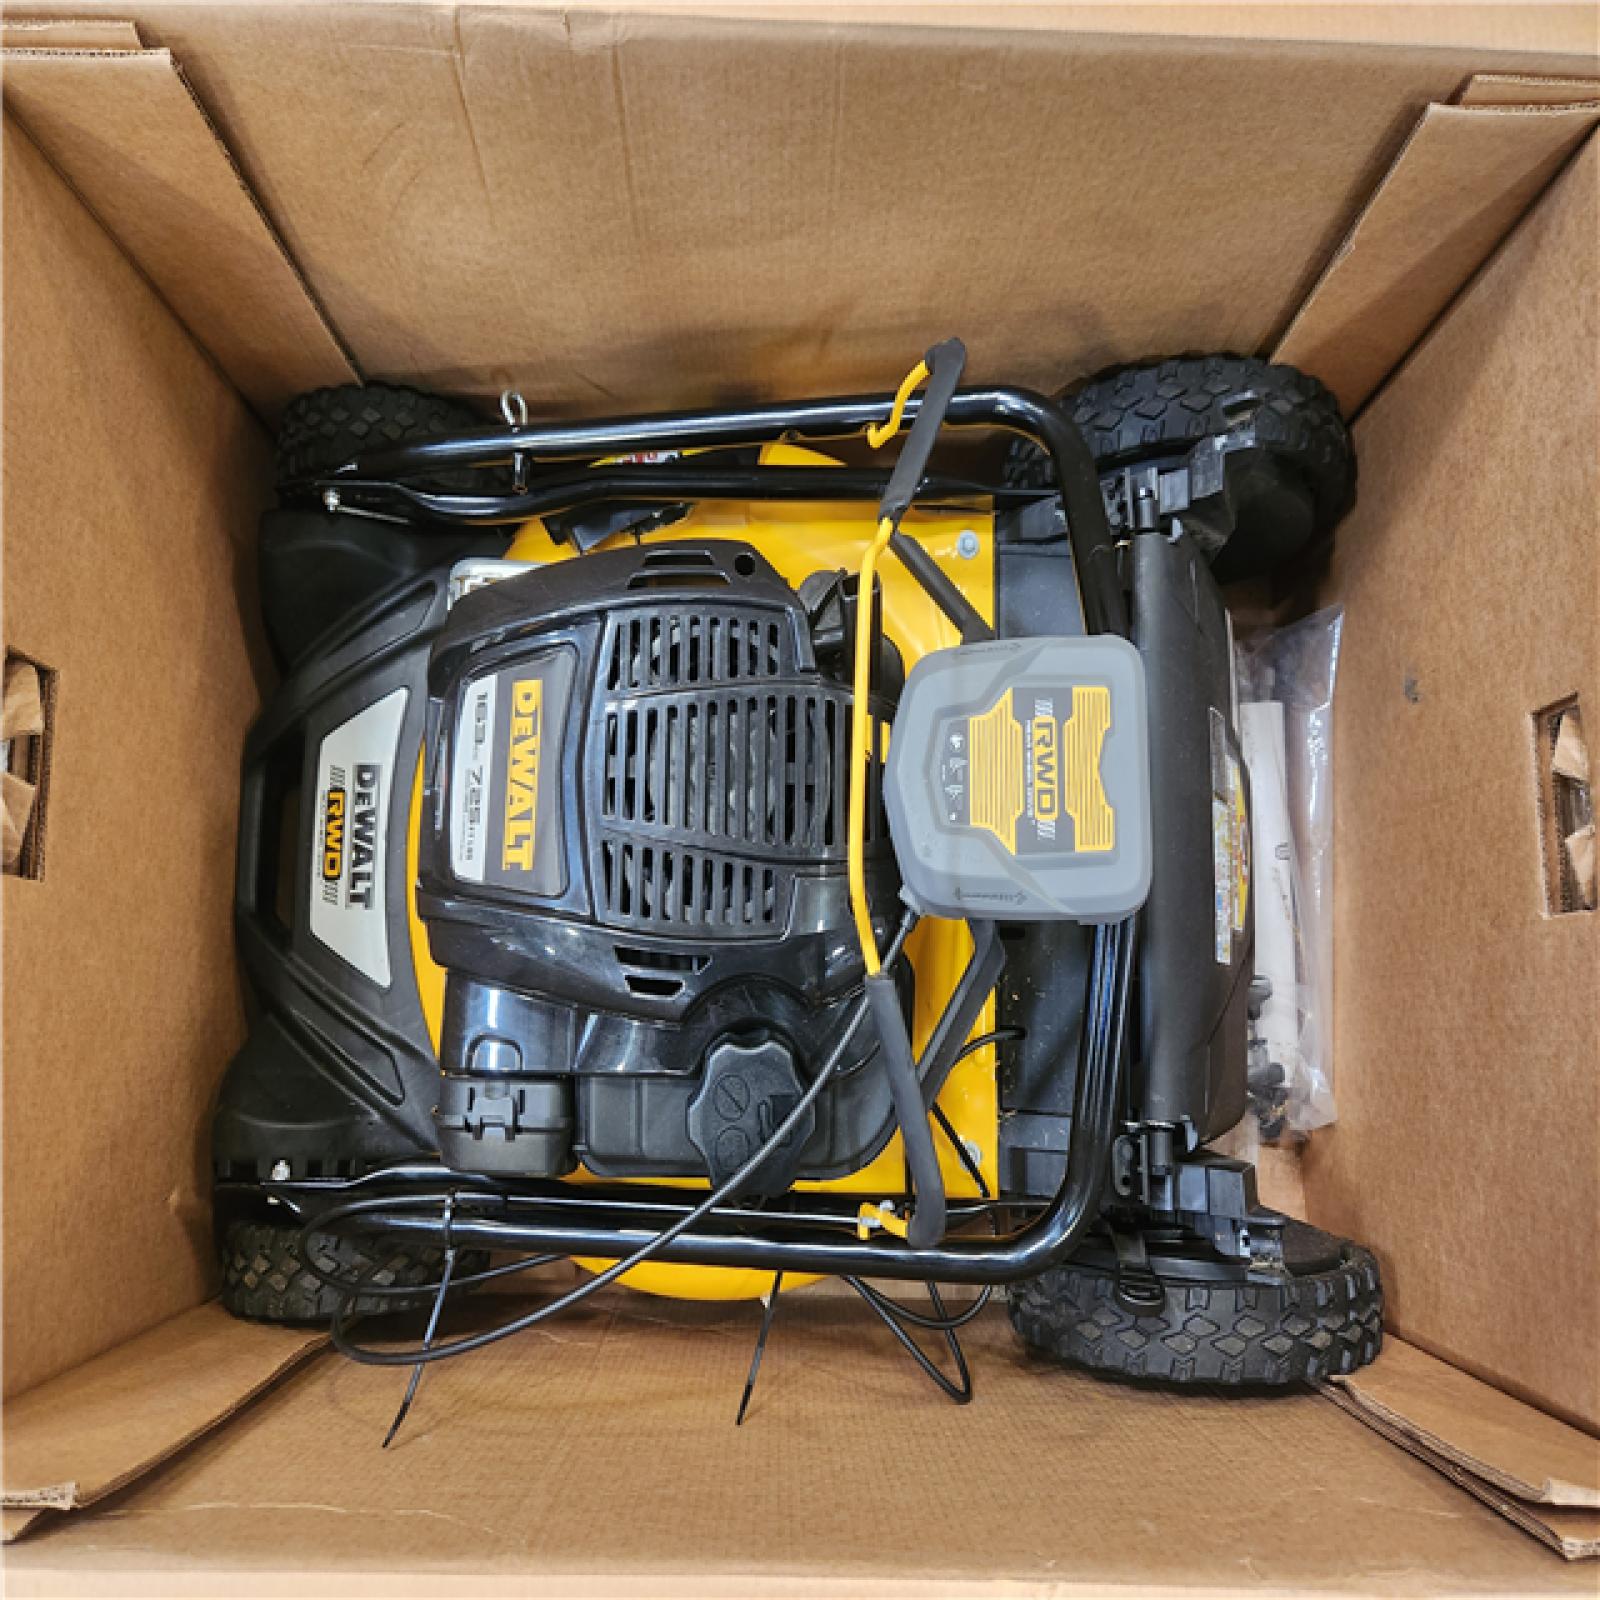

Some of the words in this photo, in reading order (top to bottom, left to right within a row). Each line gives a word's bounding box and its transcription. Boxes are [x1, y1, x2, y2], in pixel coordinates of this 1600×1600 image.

[502, 679, 543, 871] DEWALT
[1035, 720, 1057, 817] RWD
[323, 790, 345, 880] RWD
[347, 765, 382, 910] DEWALT
